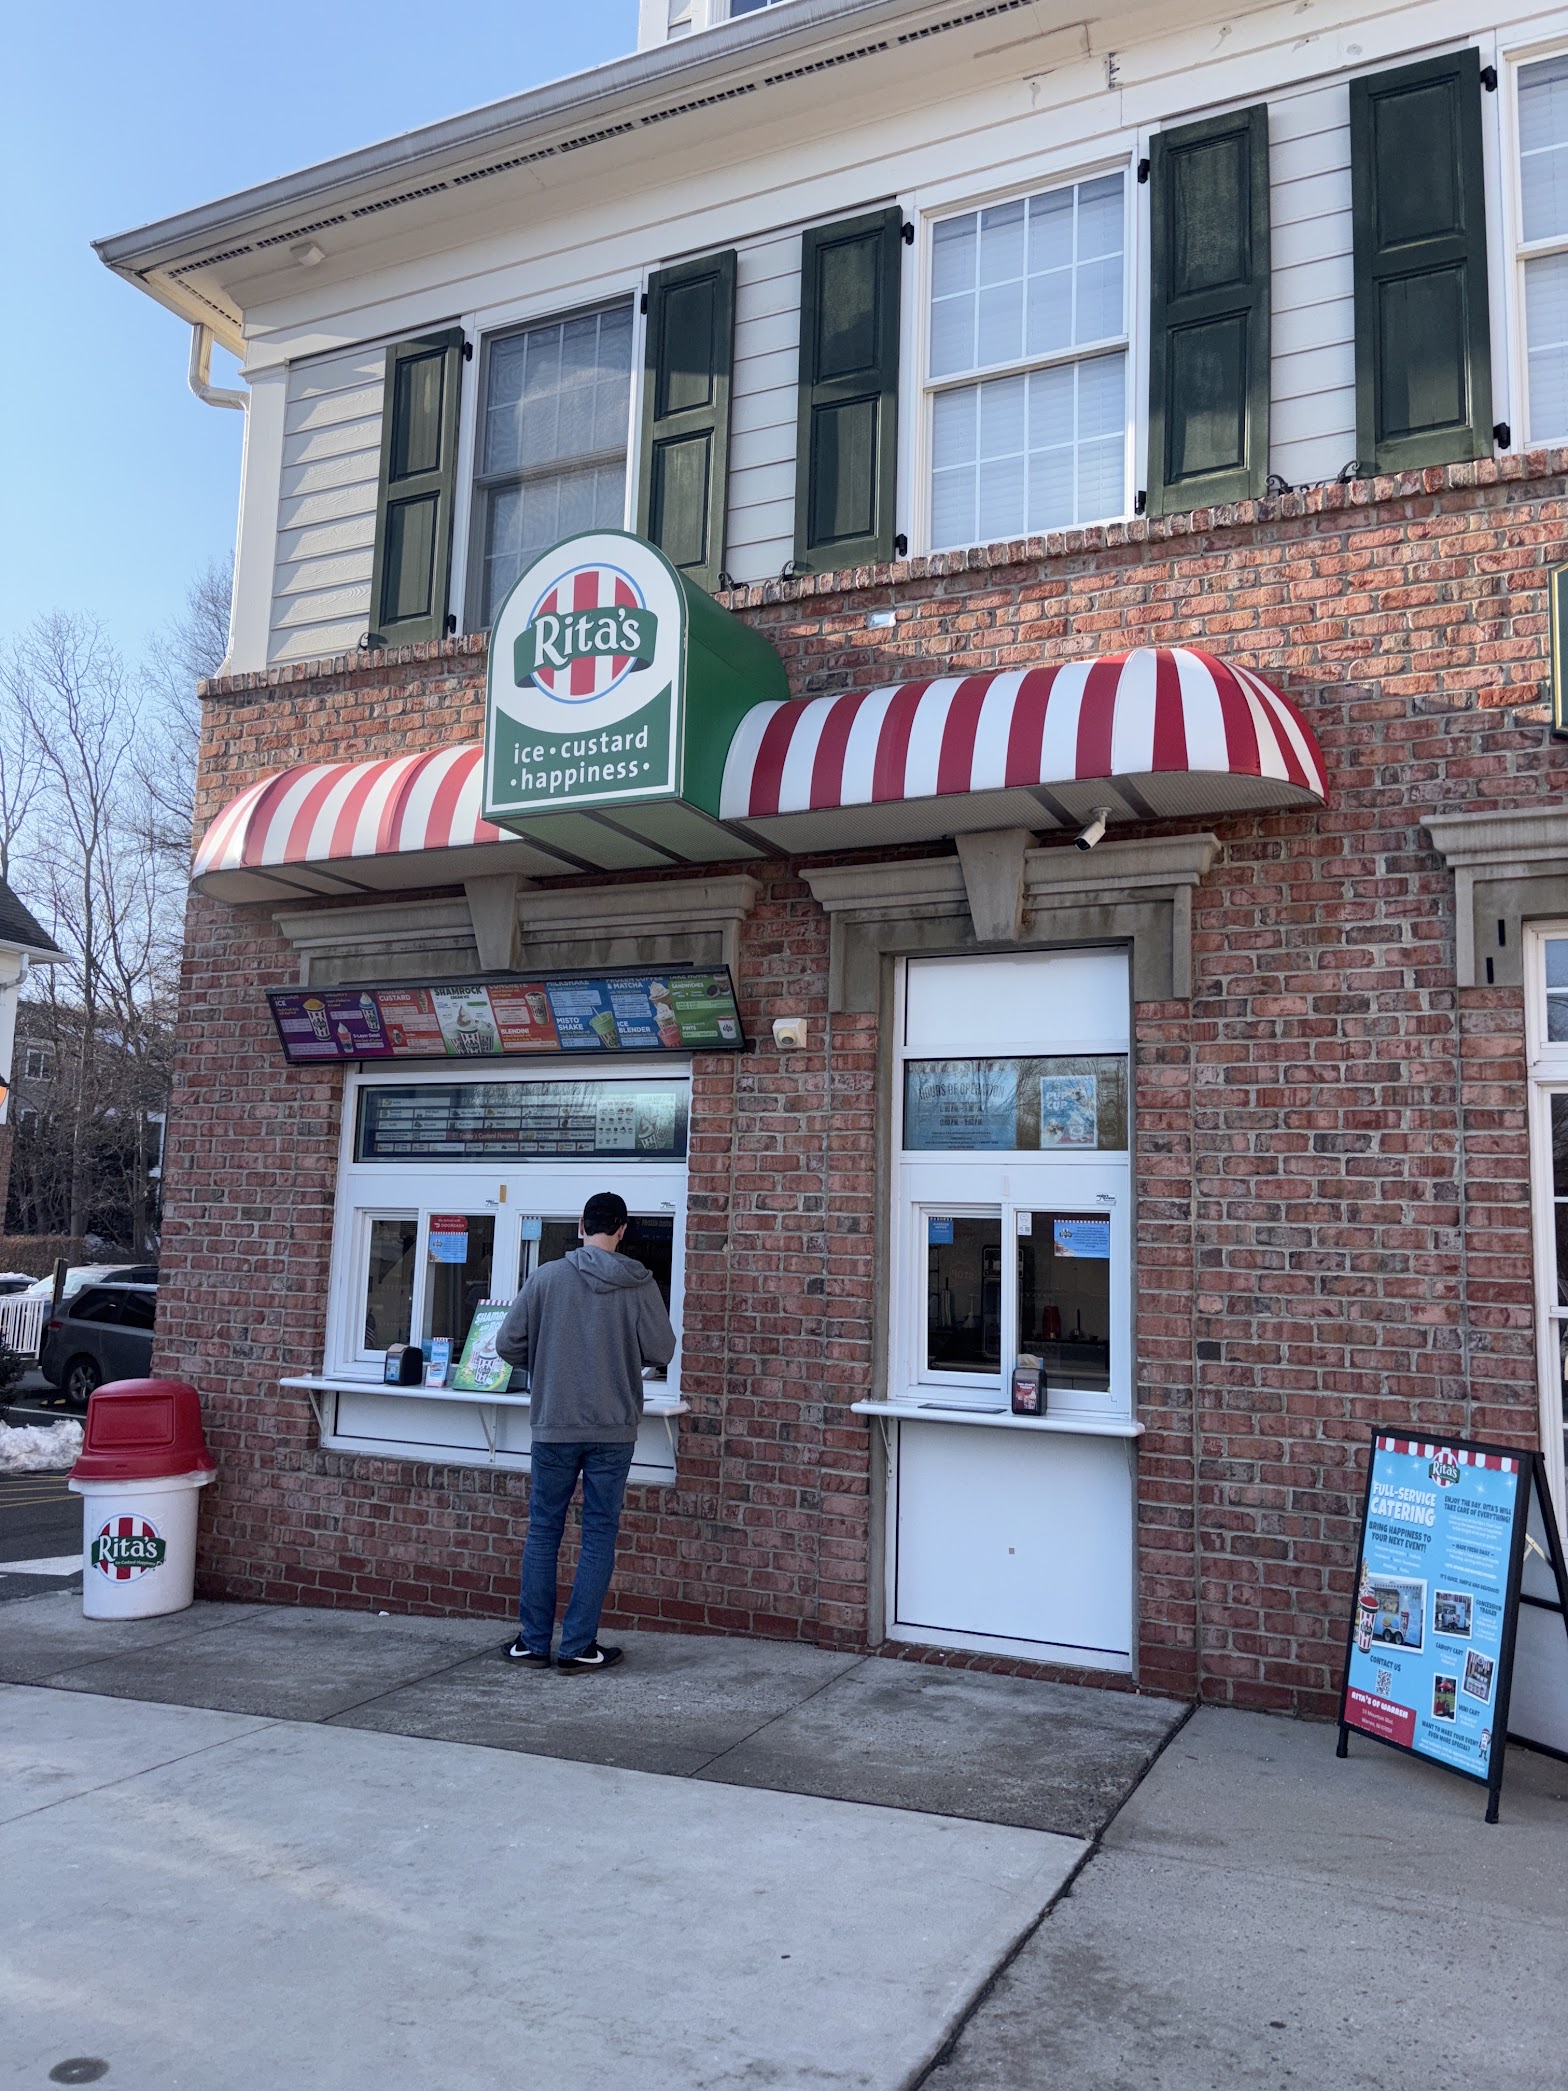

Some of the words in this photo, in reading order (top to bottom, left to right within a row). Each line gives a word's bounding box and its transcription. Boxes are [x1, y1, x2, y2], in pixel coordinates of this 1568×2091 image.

[533, 607, 641, 668] Rita's
[514, 743, 545, 765] ice
[561, 725, 649, 759] custard
[521, 761, 639, 793] happiness
[434, 986, 483, 997] SHAMROCK
[613, 982, 644, 990] MATCHA
[671, 982, 705, 990] SANDWICHES
[379, 994, 411, 1002] CUSTARD
[556, 1017, 580, 1025] MISTO
[619, 1026, 651, 1034] BLENDER
[919, 1083, 946, 1101] HOURS
[1046, 1100, 1068, 1110] CUP
[1432, 1460, 1458, 1479] Rita's
[1372, 1481, 1438, 1508] FULL-SERVICE
[1370, 1497, 1437, 1528] CATERING
[1444, 1495, 1461, 1505] ENJOY
[1461, 1499, 1471, 1507] THE
[1483, 1503, 1499, 1513] RITA'S
[1499, 1506, 1512, 1515] WILL
[1444, 1503, 1457, 1512] TAKE
[1457, 1506, 1470, 1515] CARE
[1470, 1509, 1478, 1517] OF
[1477, 1509, 1511, 1524] EVERYTHING!
[1368, 1521, 1388, 1533] BRING
[1388, 1525, 1423, 1541] HAPPINESS
[1423, 1533, 1433, 1543] TO
[99, 1535, 158, 1562] Rita's
[1371, 1531, 1389, 1543] YOUR
[1388, 1535, 1405, 1547] NEXT
[1404, 1539, 1427, 1553] EVENT!
[1452, 1648, 1464, 1656] CART
[1370, 1655, 1393, 1669] CONTACT
[1393, 1663, 1402, 1672] US
[1351, 1691, 1372, 1705] RITA'S
[1371, 1699, 1382, 1708] OF
[1381, 1701, 1409, 1719] WARREN
[1468, 1707, 1481, 1717] CART
[1422, 1720, 1435, 1730] WANT
[1434, 1724, 1441, 1732] TO
[1440, 1726, 1453, 1737] MAKE
[1453, 1731, 1465, 1741] YOUR
[1428, 1730, 1439, 1741] EVEN
